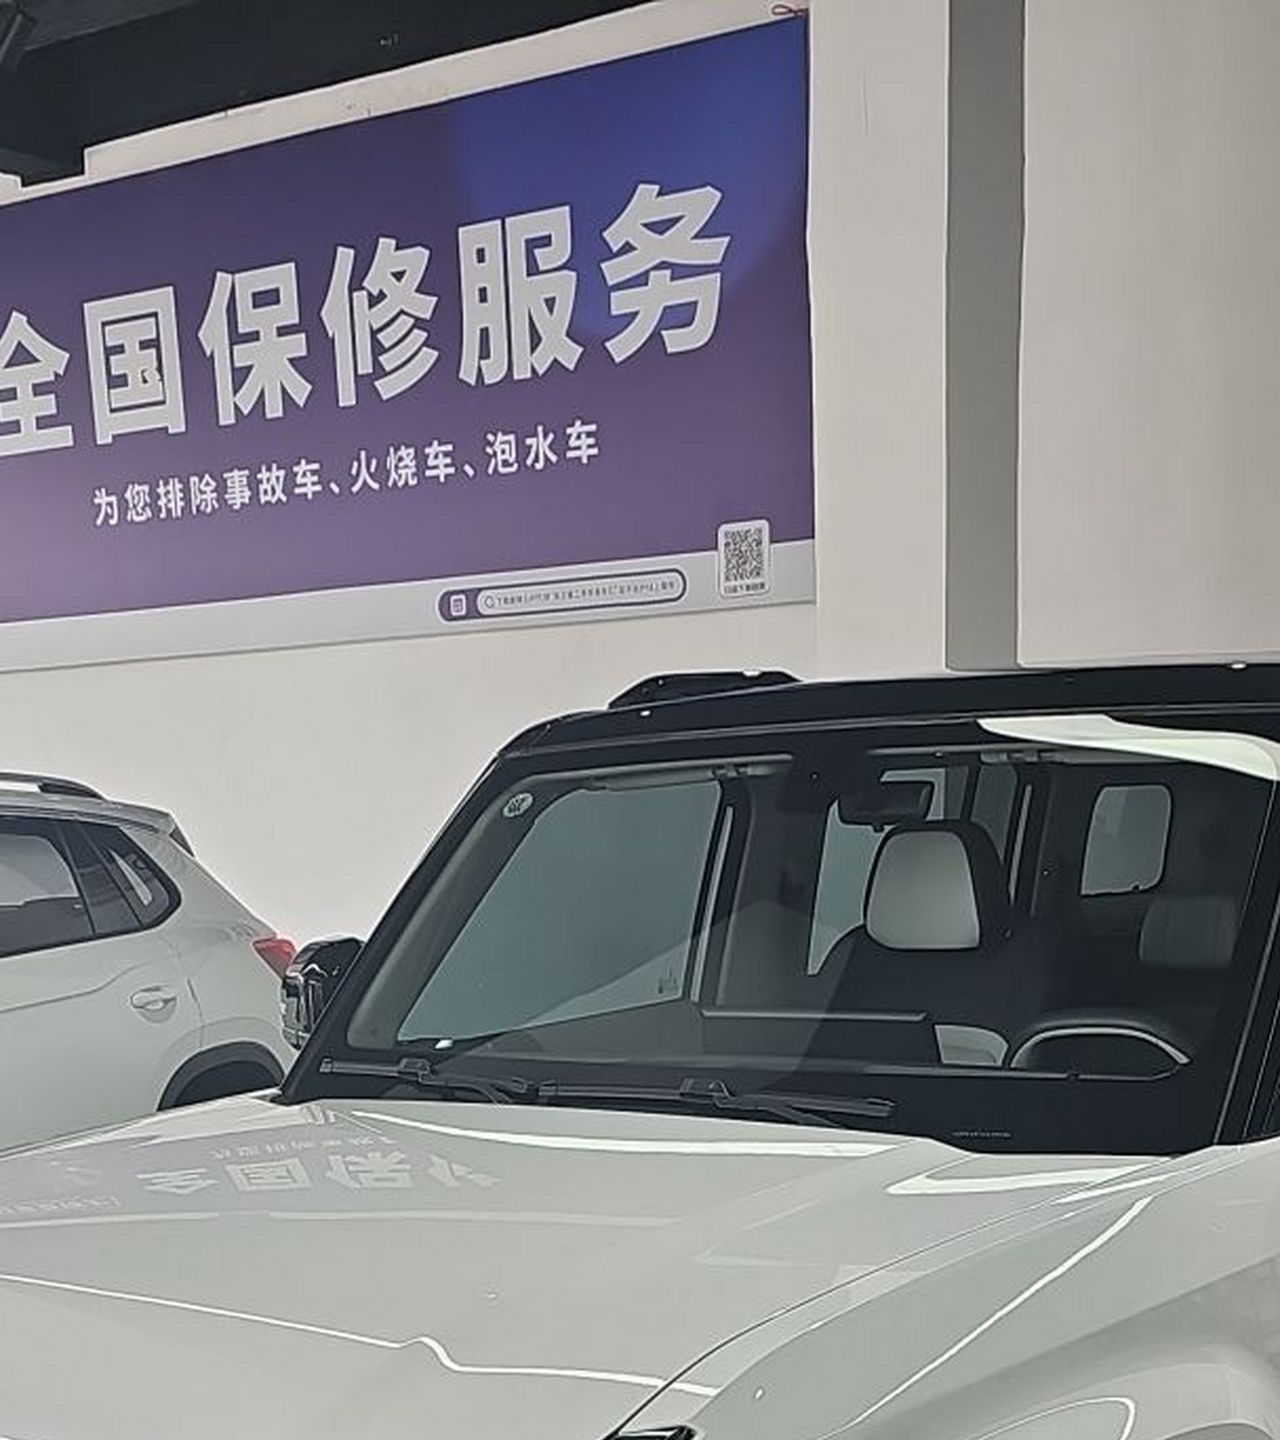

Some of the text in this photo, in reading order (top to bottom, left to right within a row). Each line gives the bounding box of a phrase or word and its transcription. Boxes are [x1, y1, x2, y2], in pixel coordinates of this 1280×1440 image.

[93, 419, 600, 527] 为您排除事故车、火烧车、泡水车
